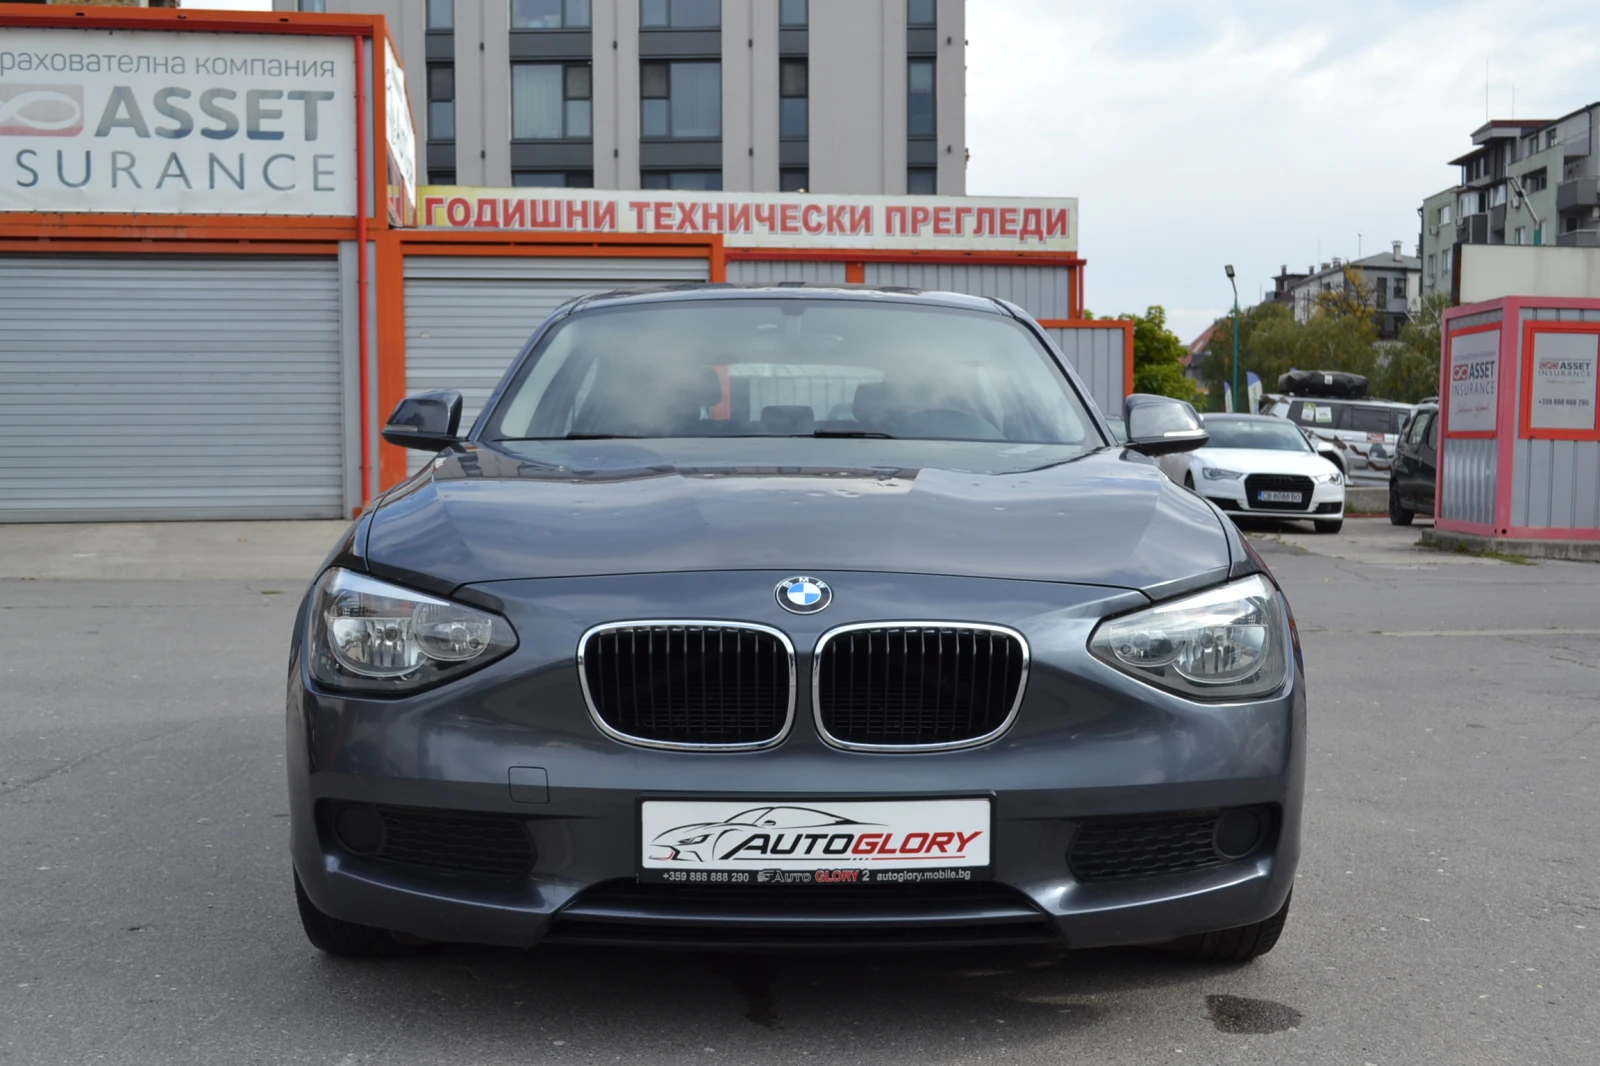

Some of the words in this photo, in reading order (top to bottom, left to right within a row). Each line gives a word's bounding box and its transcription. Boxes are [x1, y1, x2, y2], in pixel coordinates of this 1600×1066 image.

[0, 51, 186, 77] рахователна
[195, 56, 335, 79] компания
[94, 86, 335, 141] ASSET
[15, 149, 336, 192] SURANCE
[424, 196, 617, 231] ГОДИШНИ
[629, 200, 873, 236] ТЕХНИЧЕСКИ
[885, 205, 1070, 244] ПРЕГЛЕДИ
[1469, 360, 1495, 380] ASSET
[1538, 369, 1591, 377] INSURANCE
[1560, 362, 1591, 371] ASSET
[1451, 380, 1496, 397] INSURANCE
[782, 577, 827, 588] BMW
[718, 831, 984, 862] AUTOGLORY
[662, 871, 687, 881] +359
[689, 872, 708, 882] 888
[710, 872, 729, 882] 888
[731, 872, 750, 882] 290
[814, 869, 859, 882] GLORY
[862, 870, 870, 881] 2
[876, 869, 971, 882] autoglory.mobile.bg
